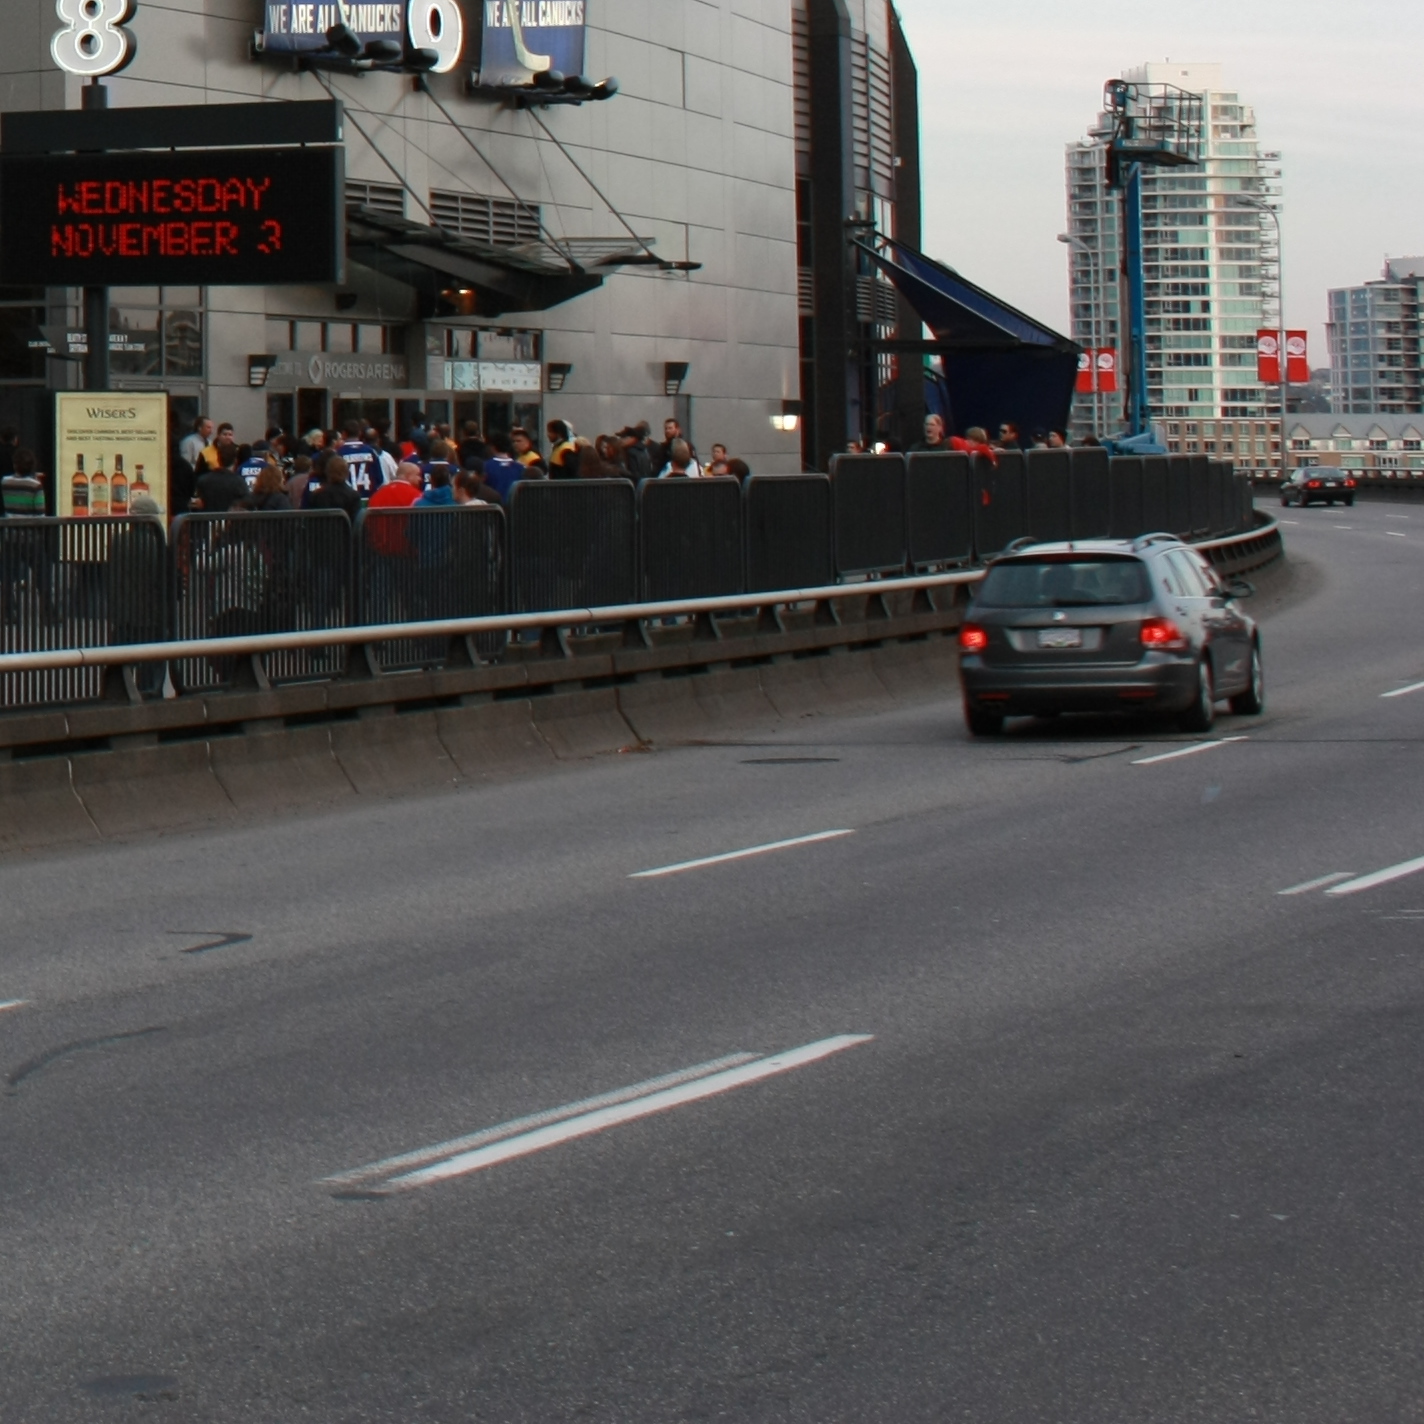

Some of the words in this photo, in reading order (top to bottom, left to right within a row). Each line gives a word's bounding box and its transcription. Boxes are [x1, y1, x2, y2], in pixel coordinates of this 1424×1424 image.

[269, 4, 287, 34] WE
[290, 4, 315, 34] ARE
[343, 3, 401, 34] CANUCKS
[486, 0, 500, 28] WE
[501, 0, 520, 28] AE
[521, 0, 538, 28] ALL
[538, 0, 584, 27] CANUCKS
[58, 177, 271, 215] WEDNESDAY
[51, 221, 239, 257] NOVEMBER
[257, 219, 282, 254] 3
[324, 361, 366, 379] ROGERS
[366, 362, 406, 380] ARENA
[349, 462, 371, 491] 14
